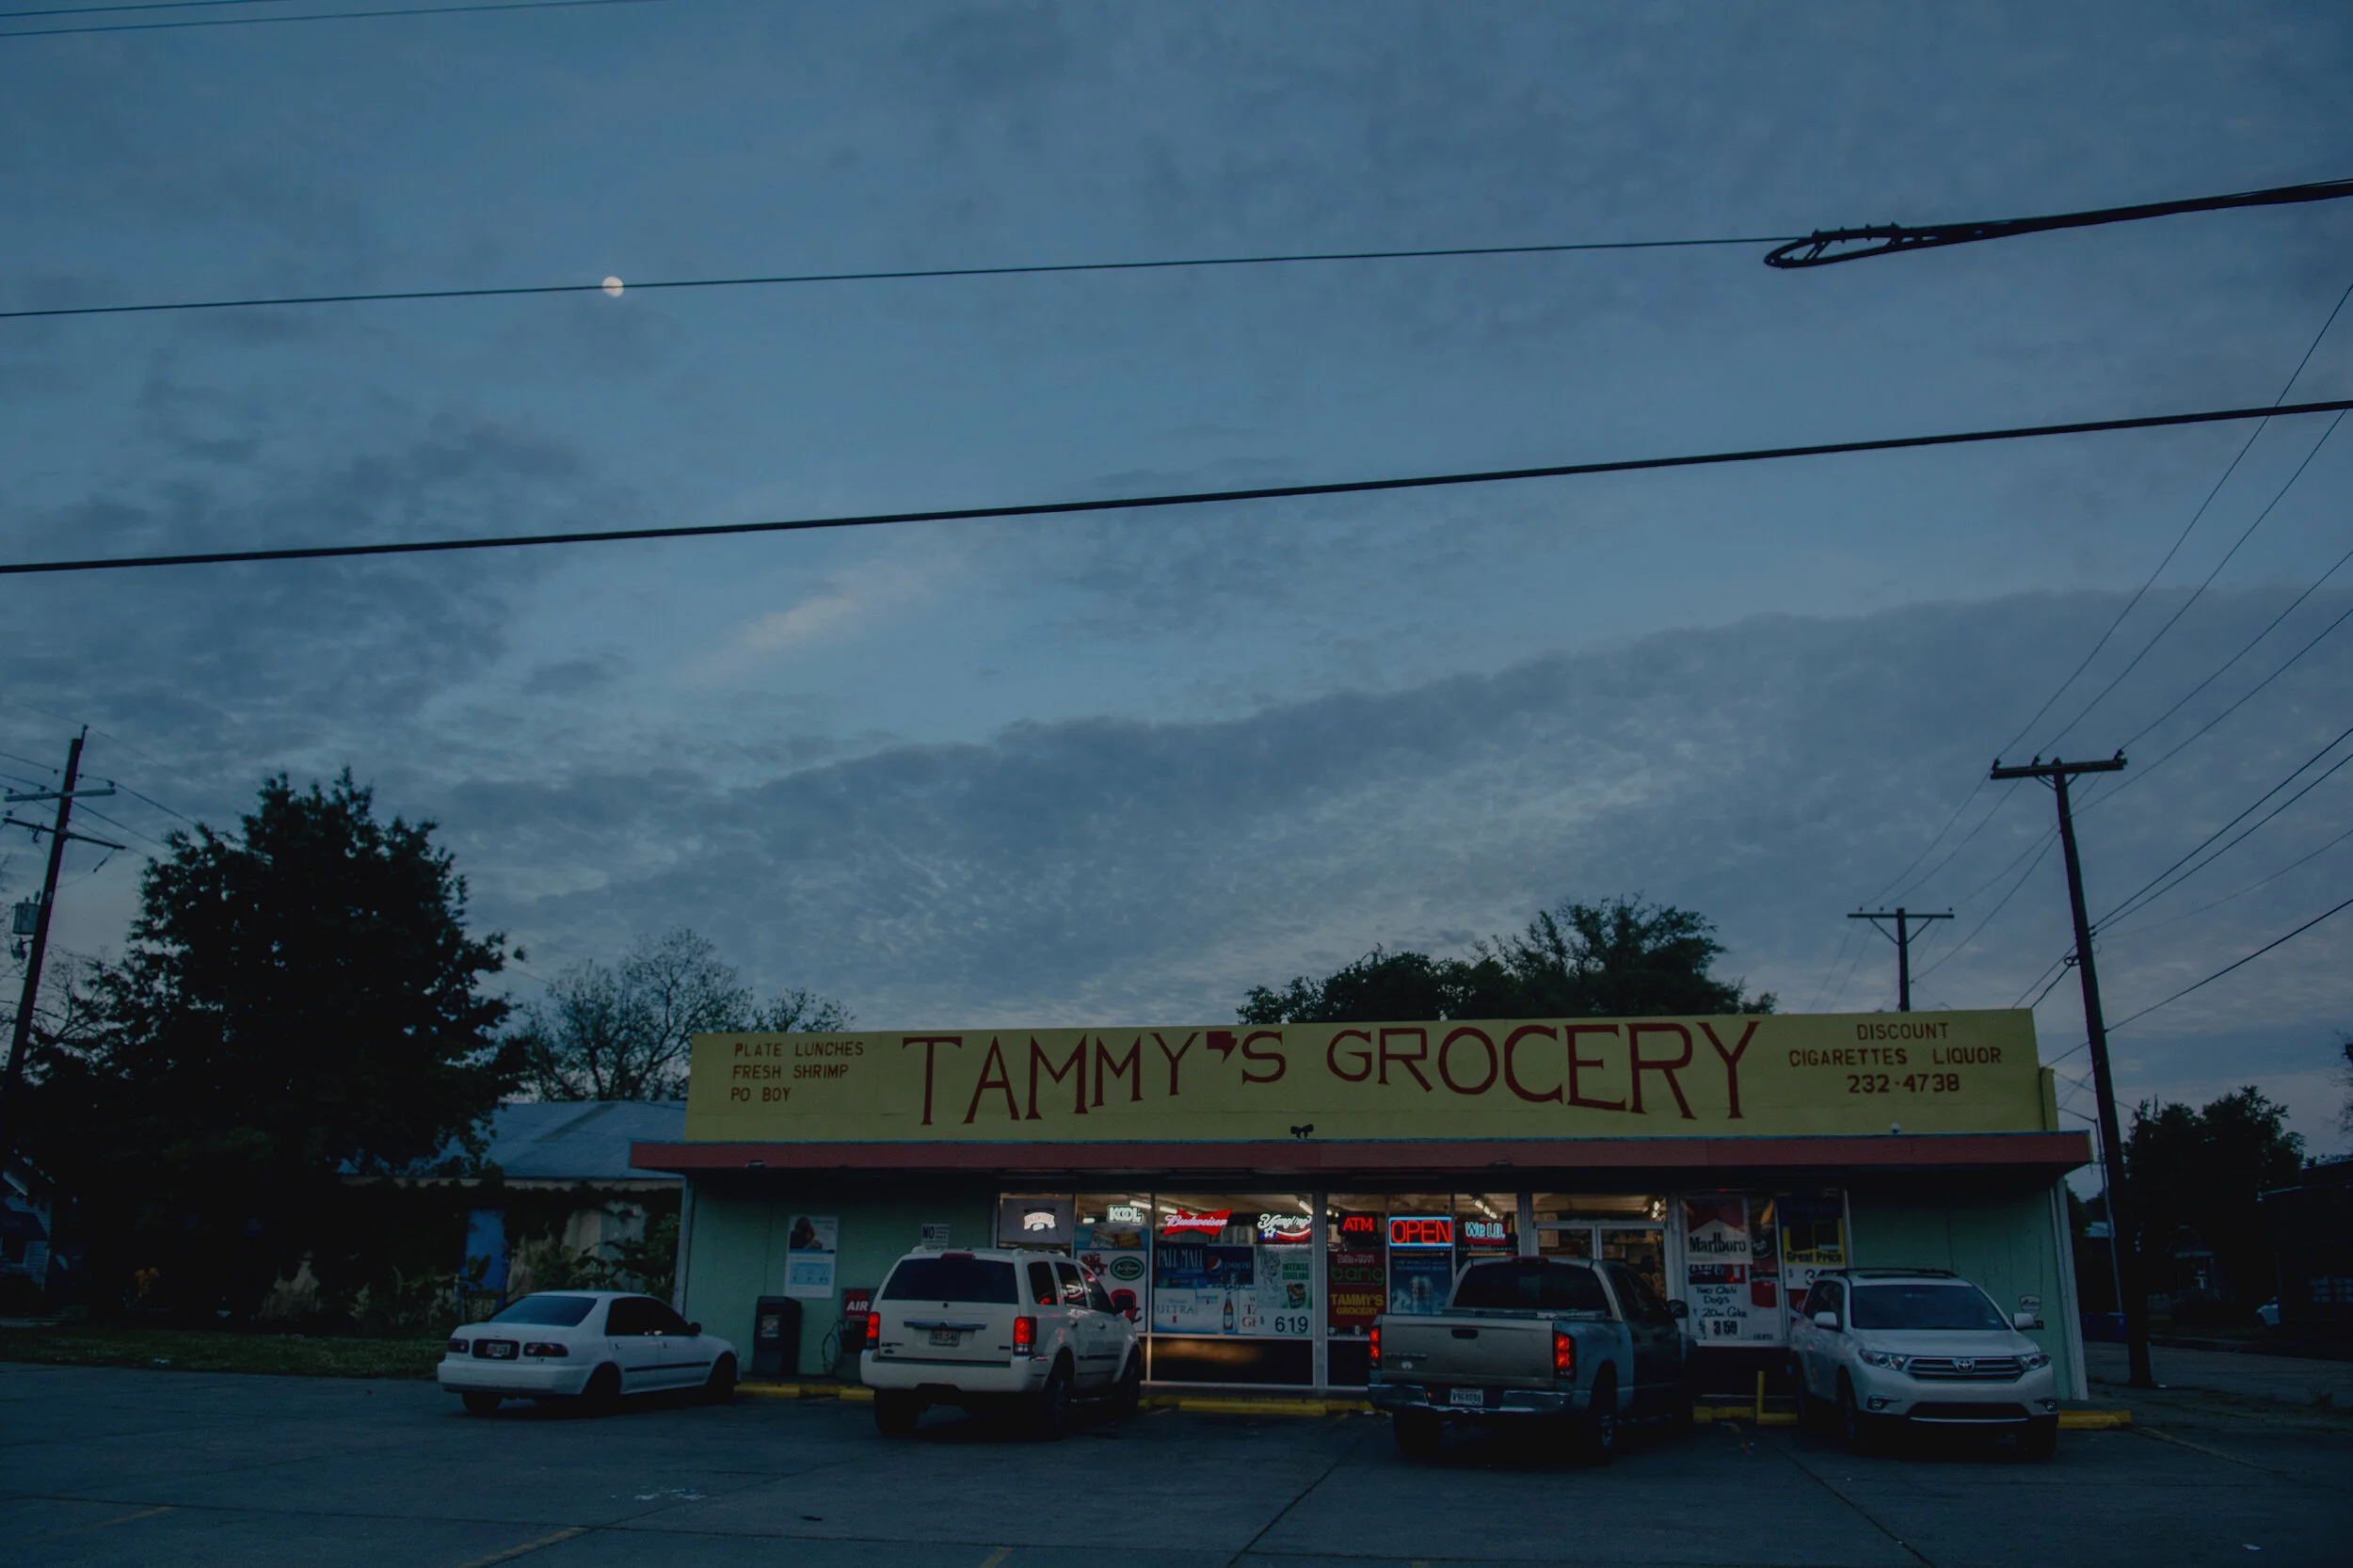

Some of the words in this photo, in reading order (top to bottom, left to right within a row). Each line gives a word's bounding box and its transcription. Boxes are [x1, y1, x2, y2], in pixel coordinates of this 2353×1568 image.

[1857, 1022, 1948, 1040] DISCOUNT
[734, 1043, 783, 1057] PLATE
[795, 1041, 864, 1056] LUNCHES
[1789, 1048, 1908, 1066] CIGARETTES
[1932, 1047, 2002, 1064] LIQUOR
[732, 1064, 781, 1080] FRESH
[792, 1064, 849, 1079] SHRIMP
[903, 1030, 1288, 1126] TAMMY'S
[1326, 1021, 1761, 1120] GROCERY
[730, 1087, 751, 1101] PO
[762, 1087, 791, 1102] BOY
[1108, 1205, 1144, 1225] KOOL
[1164, 1214, 1228, 1228] Budweiser
[922, 1226, 935, 1239] NO
[1342, 1217, 1374, 1232] ATM
[1390, 1220, 1452, 1244] OPEN
[1689, 1232, 1746, 1253] Marlboro
[1157, 1248, 1177, 1269] PALL
[1786, 1251, 1813, 1262] Great
[1817, 1252, 1842, 1262] Price
[1330, 1264, 1385, 1288] bang
[846, 1301, 868, 1311] AIR
[1330, 1294, 1385, 1306] TAMMY'S
[1157, 1304, 1195, 1315] ULTRA
[1337, 1306, 1379, 1316] GROCERY
